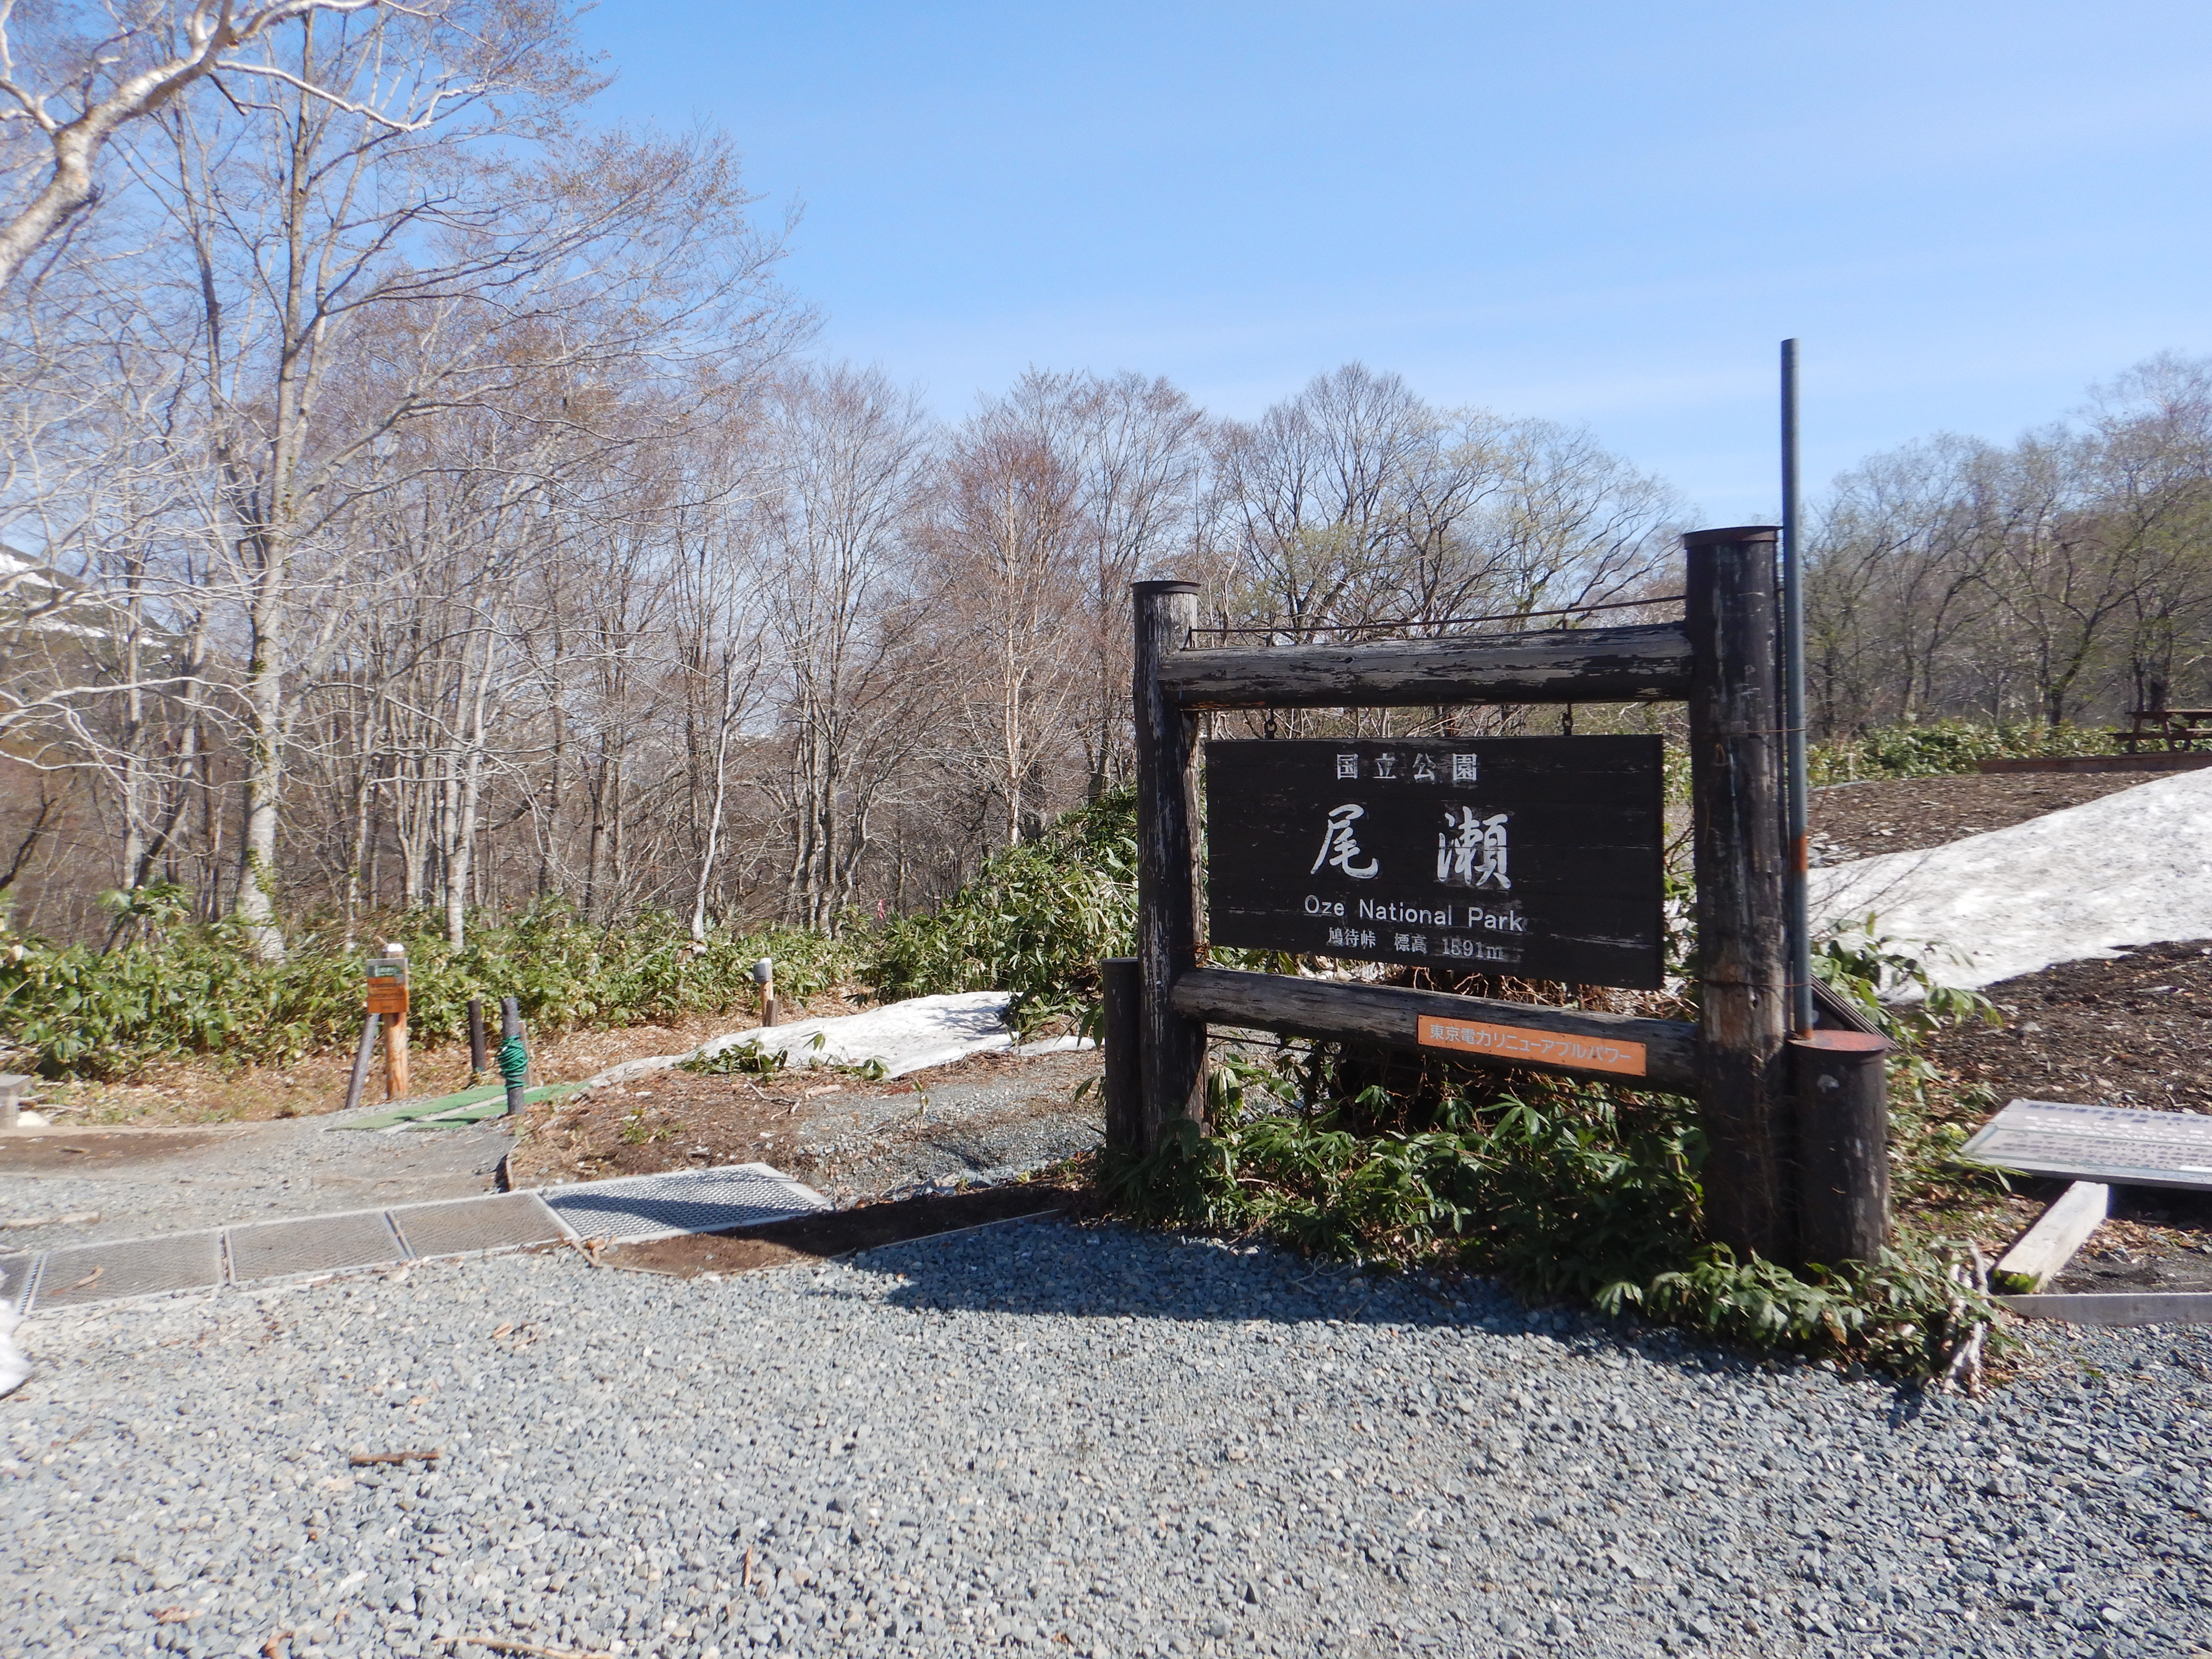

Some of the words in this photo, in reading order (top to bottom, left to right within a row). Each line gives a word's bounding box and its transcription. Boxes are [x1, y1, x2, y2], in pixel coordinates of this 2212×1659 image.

[1336, 752, 1478, 781] 国立公園
[1310, 803, 1511, 890] 尾瀬
[1304, 895, 1345, 916] Oze
[1359, 899, 1452, 926] National
[1468, 906, 1524, 932] Park
[1328, 927, 1376, 949] 鳩待峠
[1394, 933, 1428, 954] 標高
[1442, 938, 1503, 960] 1591m
[1430, 1024, 1632, 1064] 東京電力リニューアブルパワー
